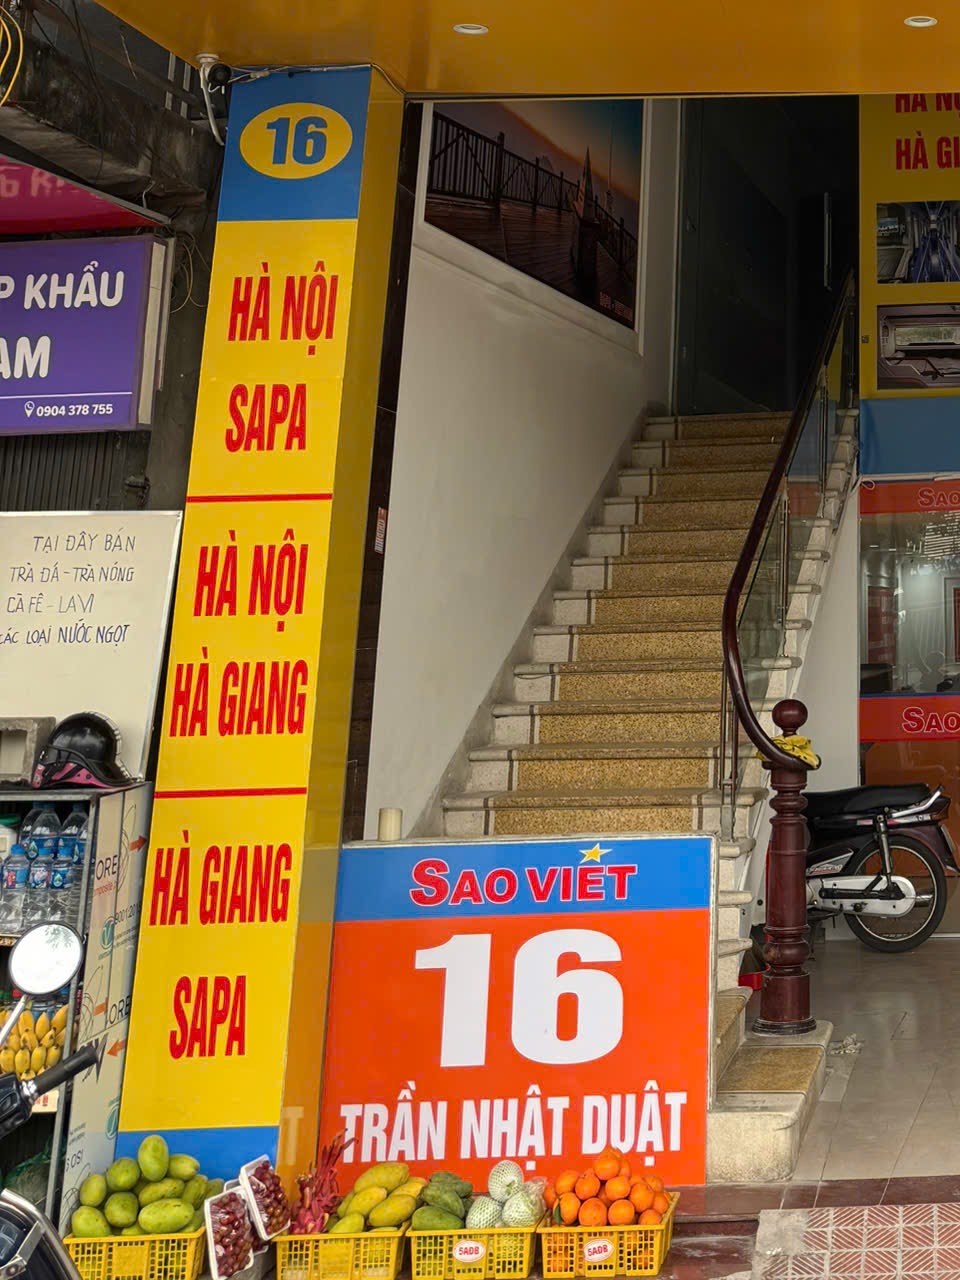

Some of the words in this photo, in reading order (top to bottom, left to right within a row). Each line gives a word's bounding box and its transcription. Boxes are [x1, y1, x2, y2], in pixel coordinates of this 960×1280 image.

[266, 116, 328, 165] 16
[896, 131, 928, 170] HÀ
[24, 261, 125, 310] KHẨU
[228, 262, 270, 342] HÀ
[280, 260, 339, 355] NỘI
[36, 405, 66, 417] 0904
[68, 404, 90, 416] 378
[91, 403, 113, 415] 755
[225, 383, 307, 453] SAPA
[10, 562, 34, 583] TRÀ
[98, 561, 135, 582] NÓNG
[33, 535, 60, 553] TẠI
[65, 531, 98, 551] ĐÂY
[104, 527, 136, 552] BÁN
[193, 530, 238, 617] HÀ
[248, 528, 309, 632] NỘI
[95, 624, 130, 647] NGỌT
[169, 647, 208, 738] HÀ
[218, 659, 309, 737] GIANG
[149, 830, 190, 926] HÀ
[199, 843, 293, 926] GIANG
[169, 975, 247, 1060] SAPA
[415, 929, 624, 1067] 16
[340, 1081, 447, 1163] TRẦN
[460, 1084, 570, 1171] NHẬT
[581, 1080, 687, 1166] DUẬT
